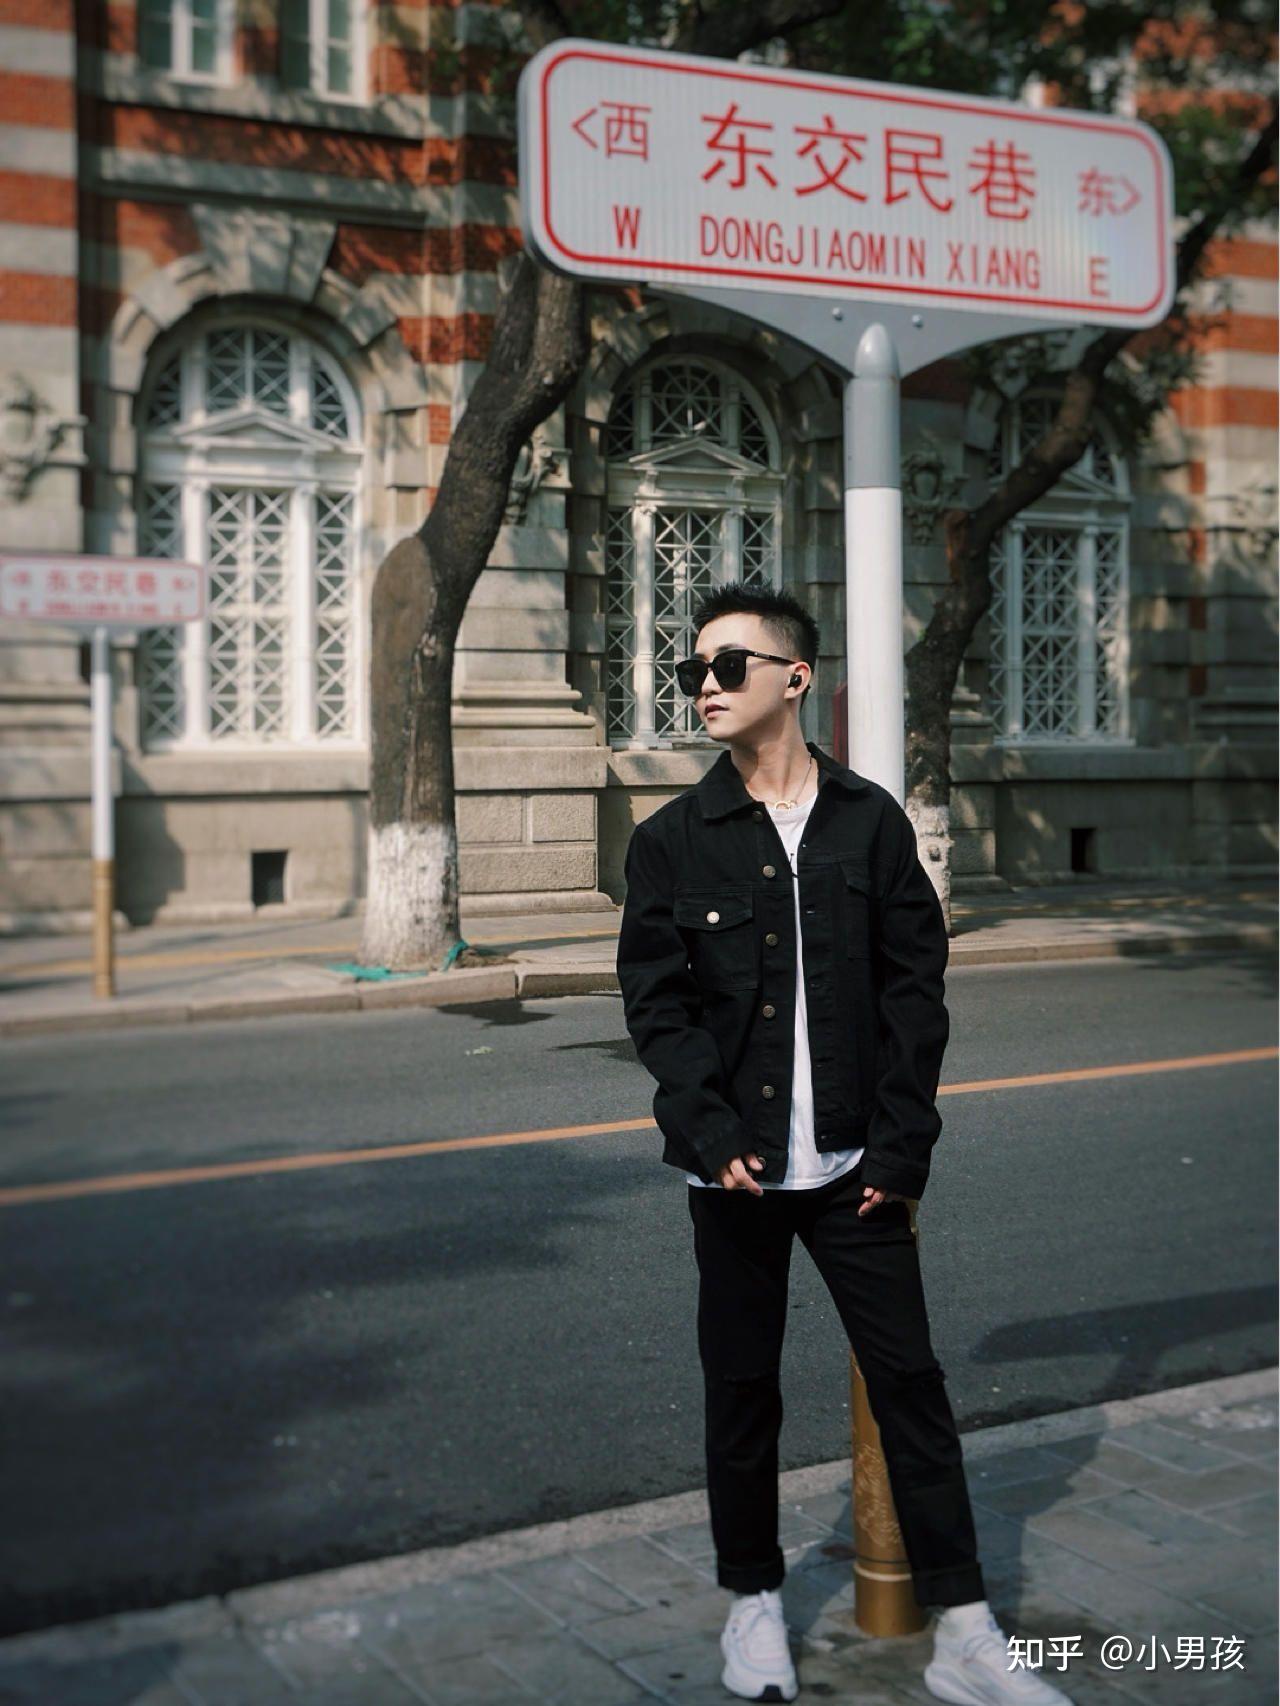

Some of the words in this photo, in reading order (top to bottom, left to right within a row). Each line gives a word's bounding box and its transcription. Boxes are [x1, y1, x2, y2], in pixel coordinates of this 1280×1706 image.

[601, 101, 651, 161] 西
[700, 103, 1036, 222] 东交民巷
[1077, 167, 1120, 217] 东
[613, 204, 641, 249] W
[700, 214, 926, 279] DONGJIAOMIN
[946, 241, 1041, 290] XIANG
[1088, 257, 1110, 298] E
